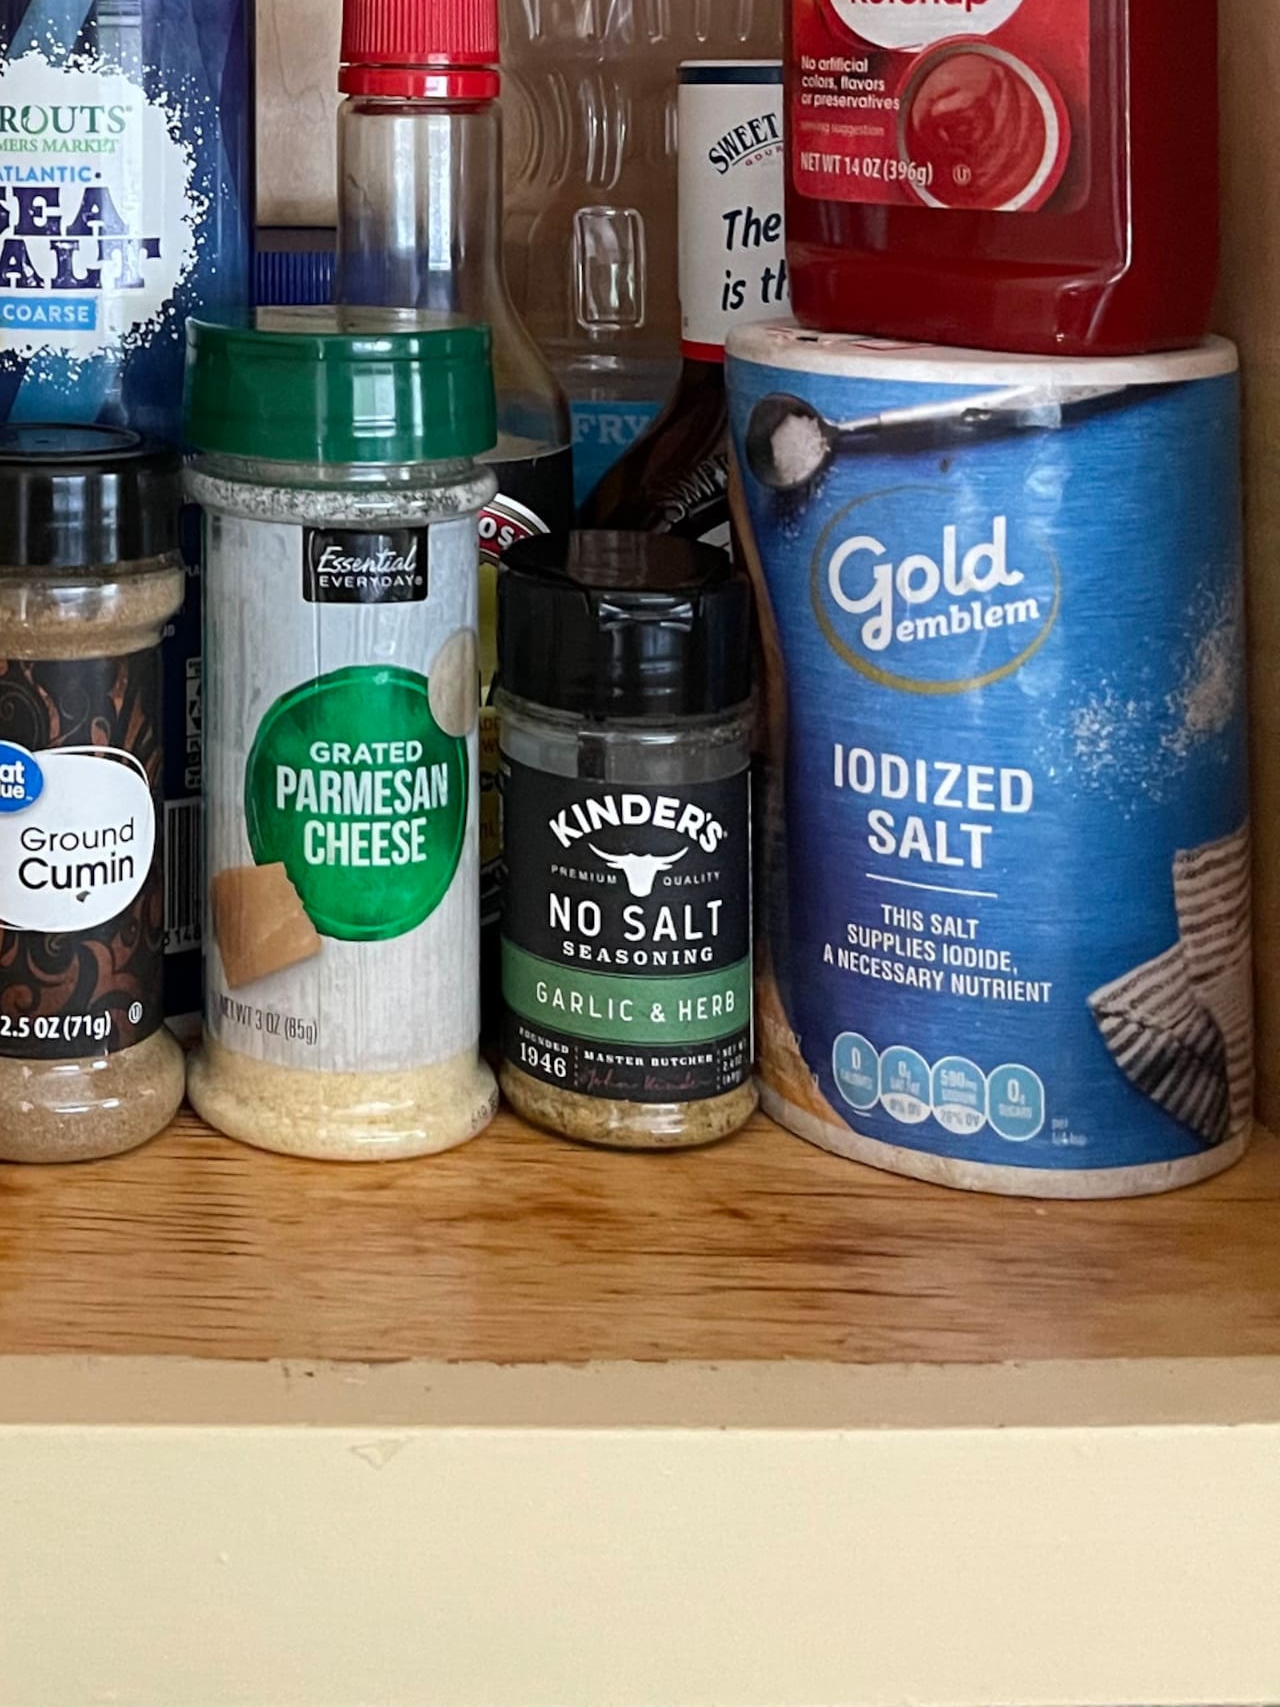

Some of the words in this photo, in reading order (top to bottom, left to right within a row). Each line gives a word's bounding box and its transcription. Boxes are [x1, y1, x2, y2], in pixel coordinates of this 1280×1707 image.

[801, 55, 816, 71] No
[818, 57, 868, 72] artificial
[801, 94, 812, 105] or
[814, 94, 900, 111] preservatives
[802, 75, 838, 91] colors,
[840, 75, 885, 92] flavors
[42, 138, 119, 154] MARKET
[708, 113, 780, 174] SWEET
[801, 152, 820, 171] NET
[822, 154, 841, 174] WT
[845, 156, 859, 176] 14
[863, 158, 881, 177] OZ
[883, 159, 933, 186] (396g)
[722, 206, 782, 251] The
[722, 270, 746, 311] is
[2, 304, 89, 323] COARSE
[317, 536, 418, 574] Essential
[319, 575, 415, 588] EVERYDAY
[828, 515, 1025, 651] Gold
[896, 598, 1040, 642] emblem
[310, 741, 422, 765] GRATED
[276, 763, 448, 815] PARMESAN
[834, 743, 1033, 814] IODIZED
[20, 817, 135, 852] Ground
[304, 818, 427, 867] CHEESE
[549, 794, 723, 853] KINDER'S
[867, 809, 992, 869] SALT
[19, 851, 135, 890] Cumin
[551, 864, 617, 885] PREMIUM
[663, 871, 720, 886] QUALITY
[549, 893, 601, 937] NO
[623, 899, 723, 942] SALT
[880, 904, 924, 932] THIS
[930, 914, 979, 939] SALT
[563, 941, 713, 966] SEASONING
[847, 923, 936, 962] SUPPLIES
[943, 945, 1019, 976] IODIDE,
[823, 943, 834, 964] A
[838, 947, 944, 992] NECESSARY
[951, 974, 1052, 1004] NUTRIENT
[536, 981, 633, 1022] GARLIC
[650, 1003, 666, 1023] &
[678, 990, 735, 1022] HERB
[0, 1014, 30, 1038] 2.5
[39, 1017, 61, 1039] OZ
[63, 1010, 111, 1040] (71g)
[235, 1002, 252, 1027] WT
[255, 1009, 263, 1030] 3
[266, 1012, 280, 1035] OZ
[285, 1016, 318, 1045] (85g)
[520, 1042, 567, 1078] 1946
[584, 1050, 644, 1067] MASTER
[651, 1053, 713, 1068] BUTCHER
